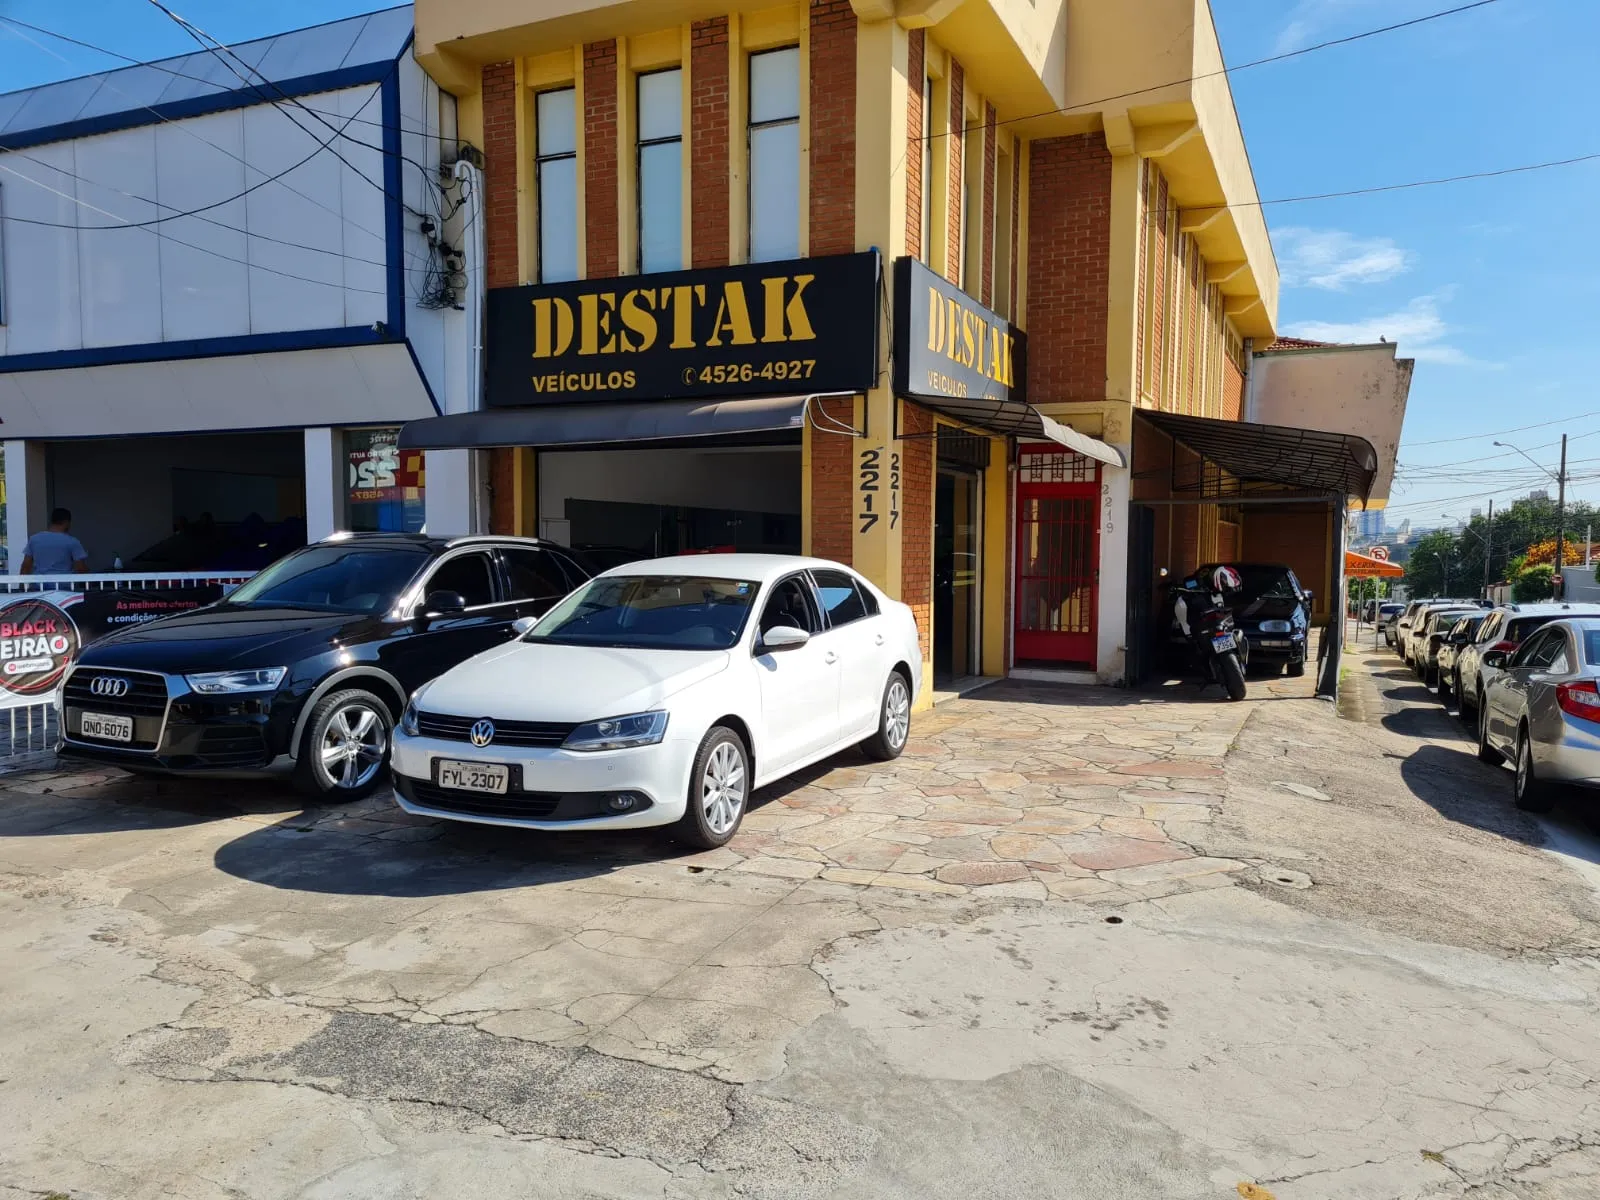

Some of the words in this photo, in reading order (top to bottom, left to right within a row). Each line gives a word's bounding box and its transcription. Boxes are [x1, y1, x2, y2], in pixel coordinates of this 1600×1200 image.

[531, 274, 817, 359] DESTAK
[928, 287, 1014, 388] DESTAK
[532, 370, 636, 393] VEÍCULOS
[699, 359, 816, 385] 4526-4927
[859, 449, 879, 534] 2217
[890, 453, 900, 530] 2217
[1102, 483, 1114, 534] 2219
[1, 619, 57, 638] BLACK
[116, 601, 128, 610] As
[129, 600, 168, 609] melhores
